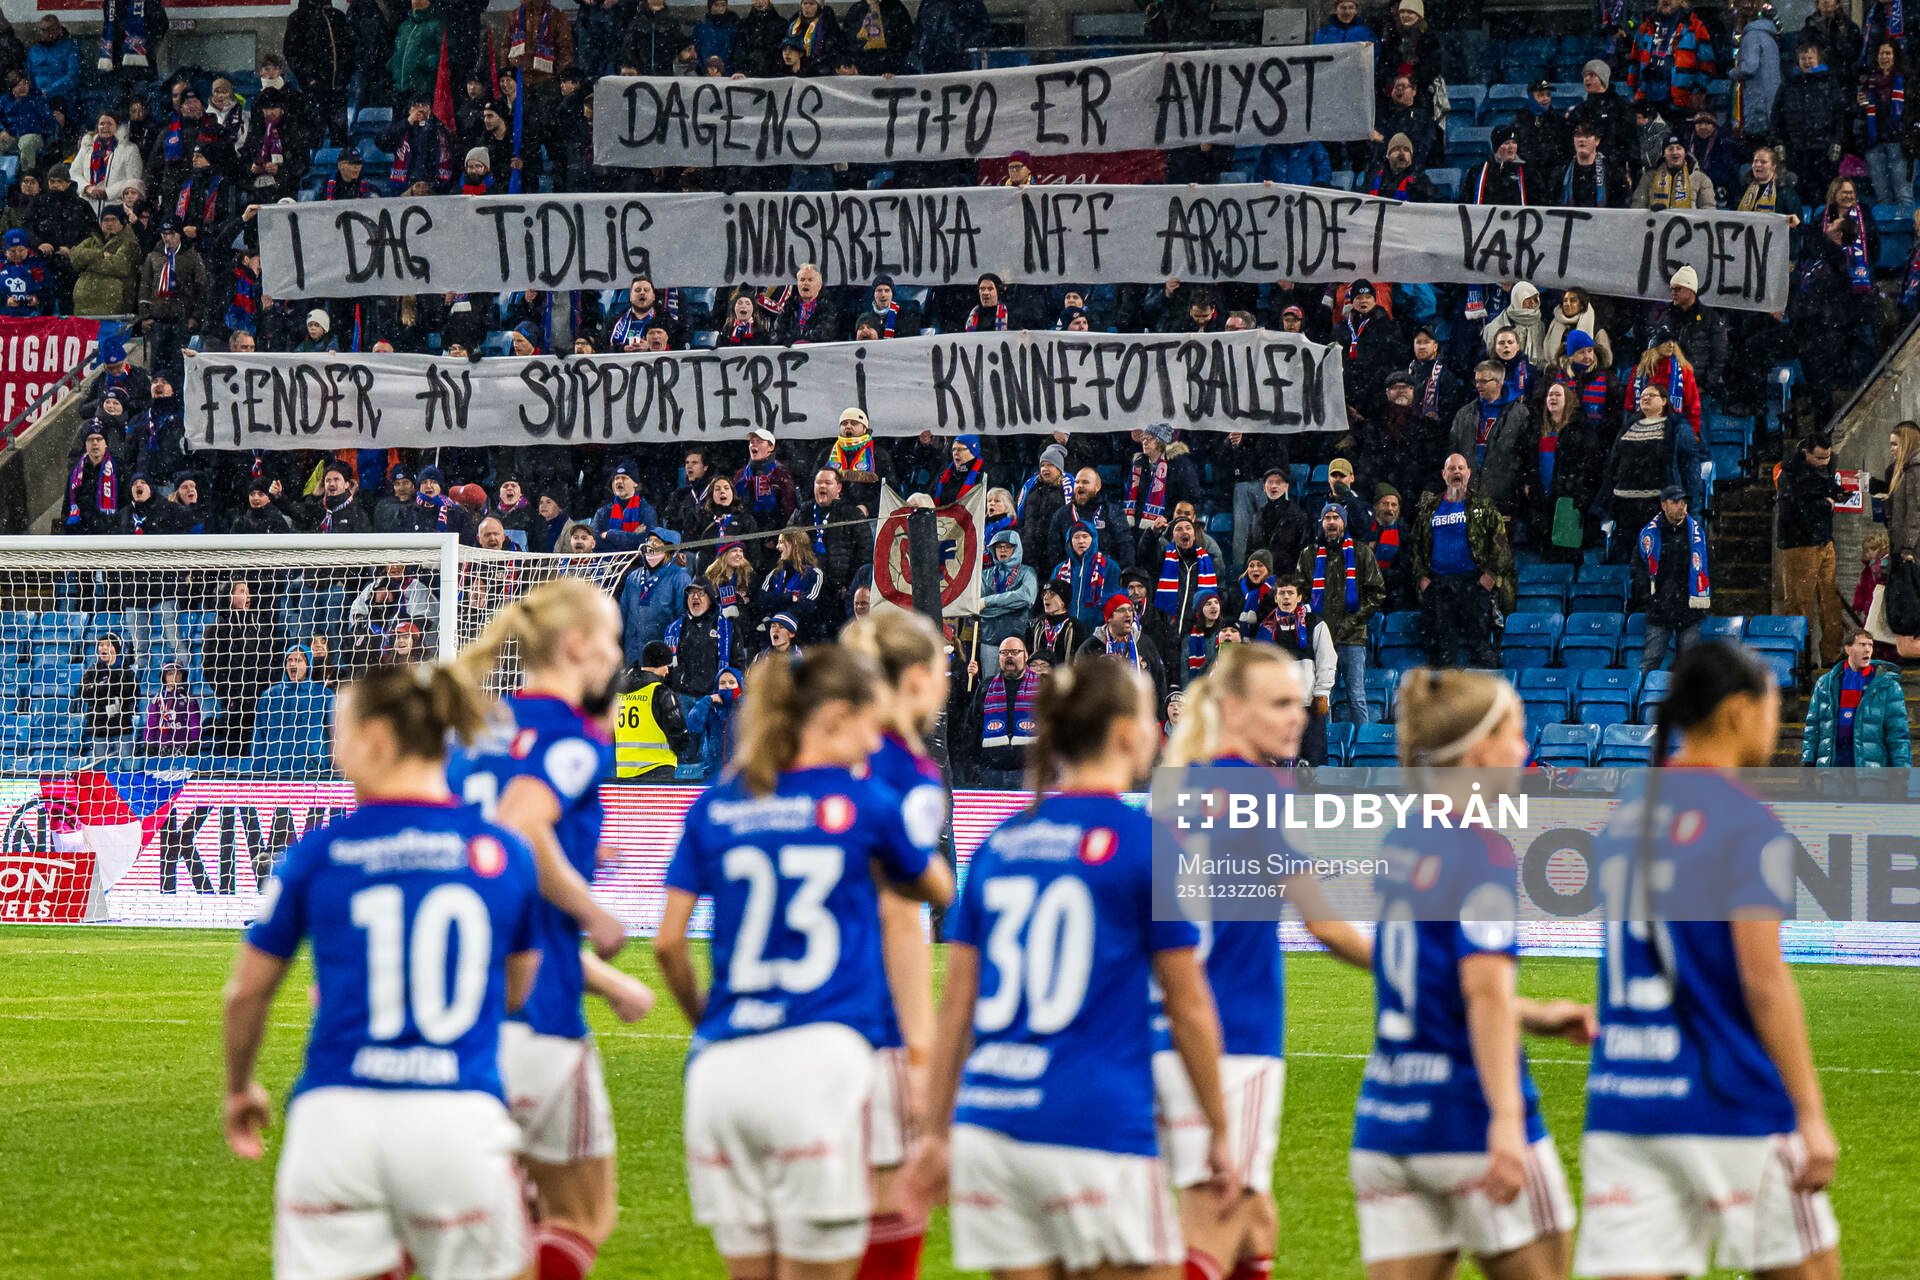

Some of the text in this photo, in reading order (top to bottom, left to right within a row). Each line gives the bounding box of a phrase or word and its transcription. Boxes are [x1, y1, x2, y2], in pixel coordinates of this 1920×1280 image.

[618, 81, 823, 166] DAGENS
[1030, 66, 1111, 146] ER
[1154, 56, 1334, 145] AVLYST
[287, 211, 304, 290] I
[335, 205, 433, 284] DAG
[1022, 192, 1114, 276] NFF
[415, 363, 473, 432] AV
[519, 351, 809, 438] SUPPORTERE
[617, 705, 640, 728] 56
[351, 883, 493, 1044] 10
[723, 845, 845, 994] 23
[975, 875, 1095, 1034] 30
